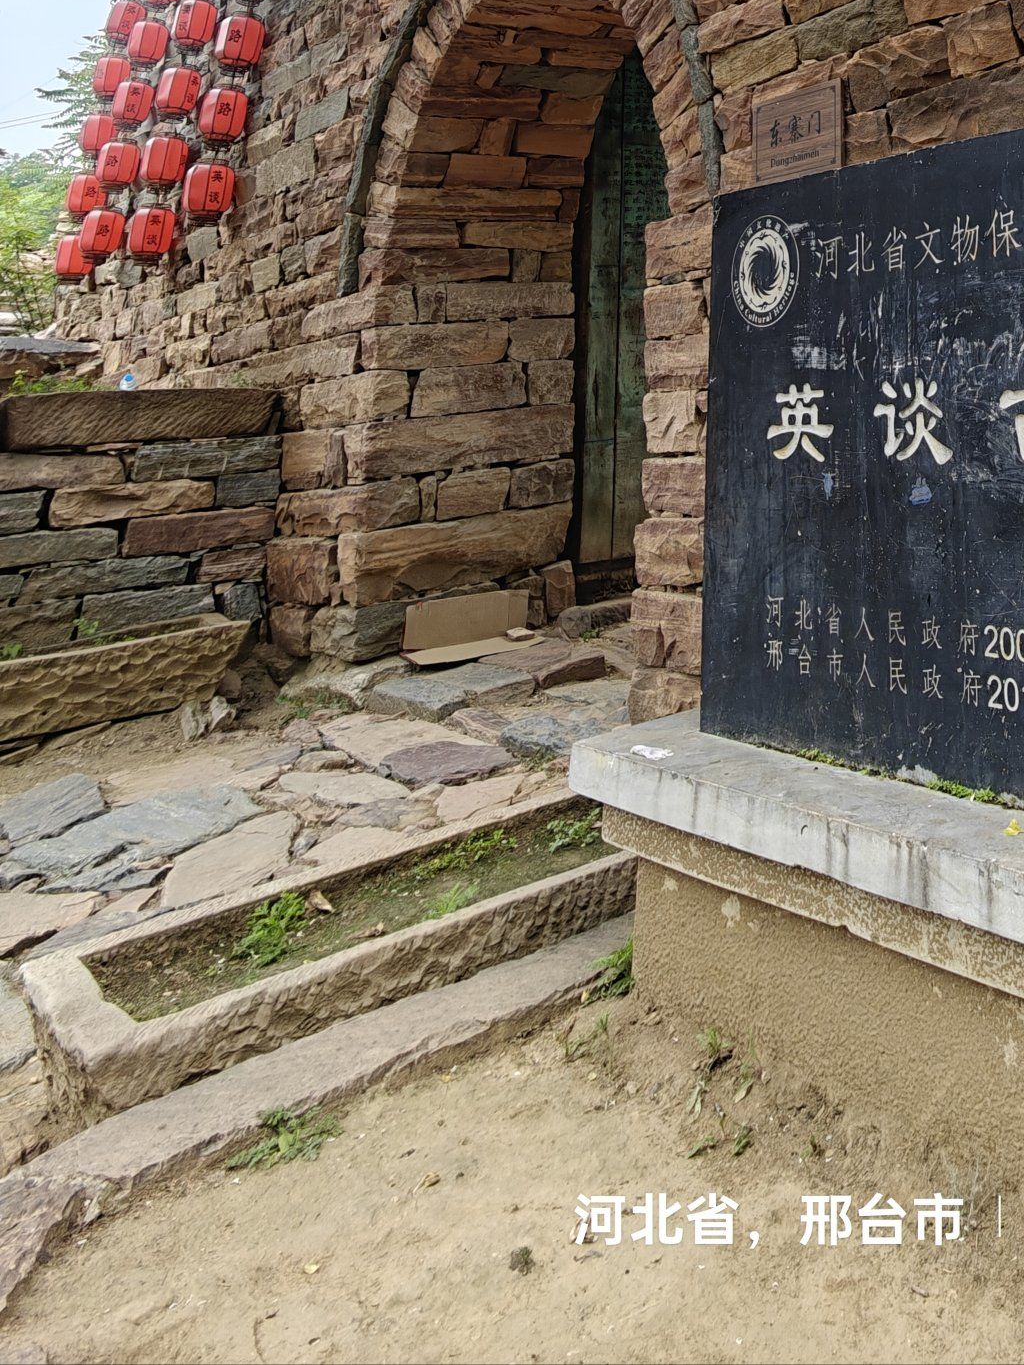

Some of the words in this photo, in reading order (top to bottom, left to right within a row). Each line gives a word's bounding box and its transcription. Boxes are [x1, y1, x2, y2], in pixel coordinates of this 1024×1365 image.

[228, 29, 242, 42] 路
[217, 102, 231, 116] 路
[770, 111, 821, 147] 东寨门
[106, 155, 118, 166] 路
[771, 150, 820, 168] Dongzhaimen
[209, 170, 223, 204] 英谈
[146, 215, 161, 246] 英谈
[744, 308, 773, 324] Cultural
